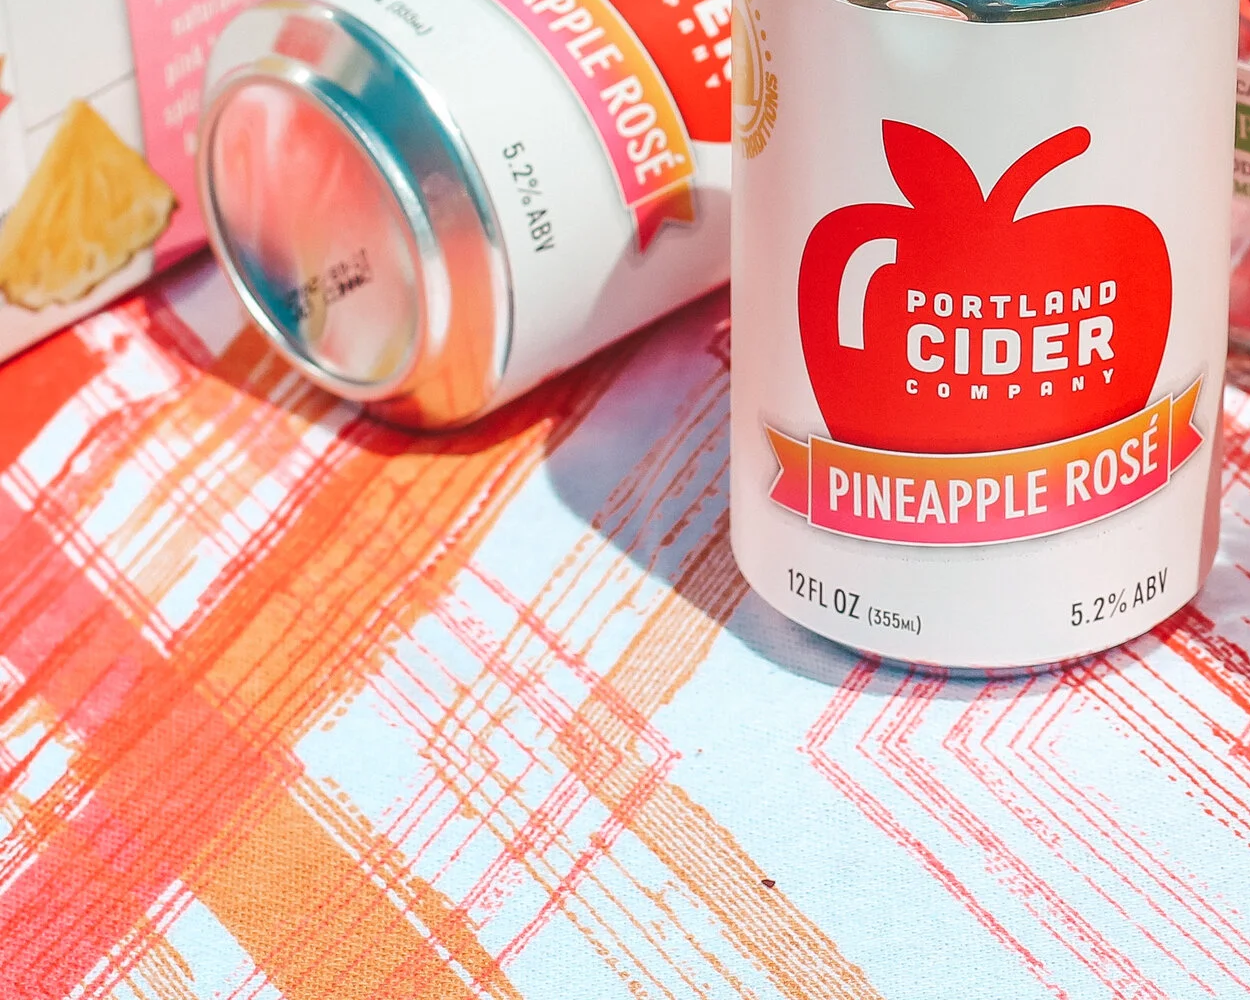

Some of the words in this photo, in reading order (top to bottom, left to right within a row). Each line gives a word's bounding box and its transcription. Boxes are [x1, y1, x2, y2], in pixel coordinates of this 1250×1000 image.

[600, 75, 681, 187] ROSÉ
[501, 141, 533, 207] 5.2%
[525, 205, 555, 255] ABV
[907, 280, 1117, 319] PORTLAND
[906, 315, 1116, 376] CIDER
[905, 369, 1116, 400] COMPANY
[828, 466, 1048, 524] PINEAPPLE
[1065, 414, 1159, 508] ROSÉ
[833, 588, 861, 620] OZ
[867, 605, 922, 636] (355ML)
[1070, 591, 1128, 627] 5.2%
[1132, 567, 1170, 609] ABV
